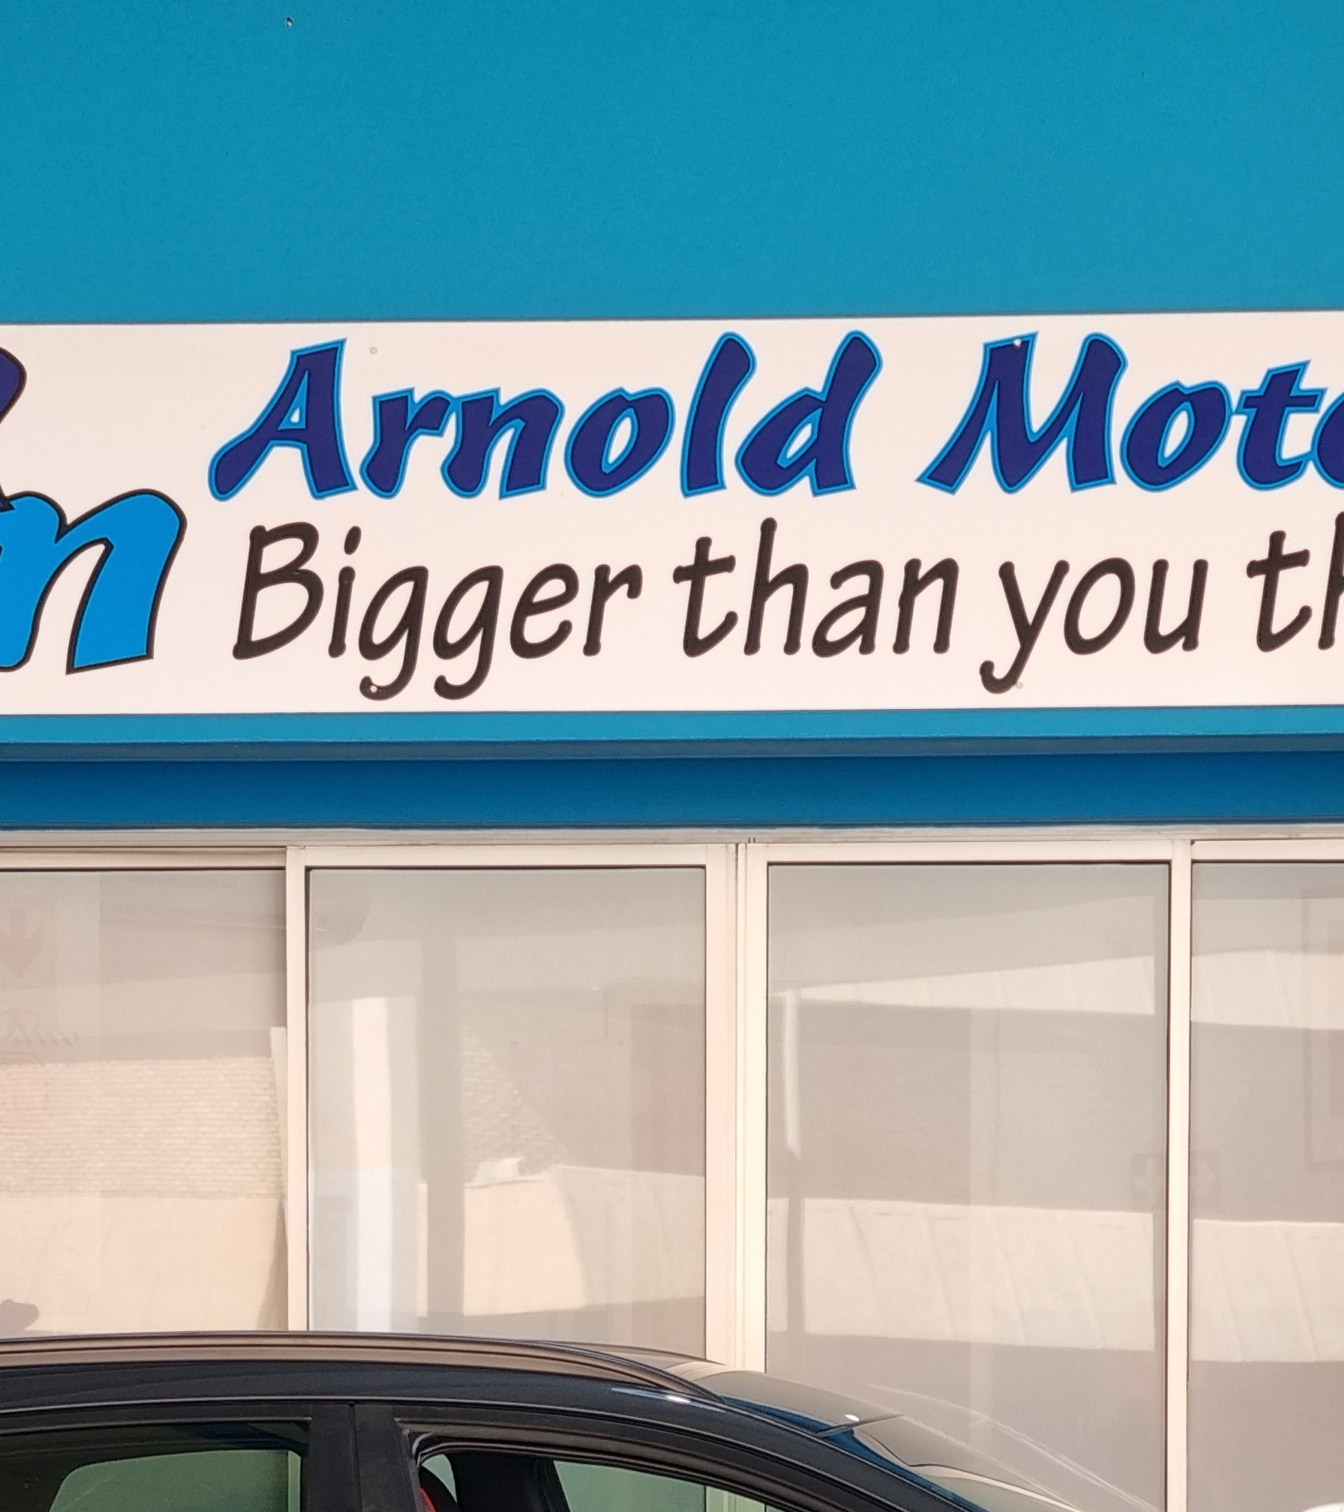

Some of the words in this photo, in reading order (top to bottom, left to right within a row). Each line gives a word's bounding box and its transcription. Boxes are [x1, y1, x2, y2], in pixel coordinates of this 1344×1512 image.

[208, 331, 883, 499] Arnold
[232, 521, 643, 700] Bigger
[672, 516, 959, 659] than
[979, 556, 1209, 694] you
